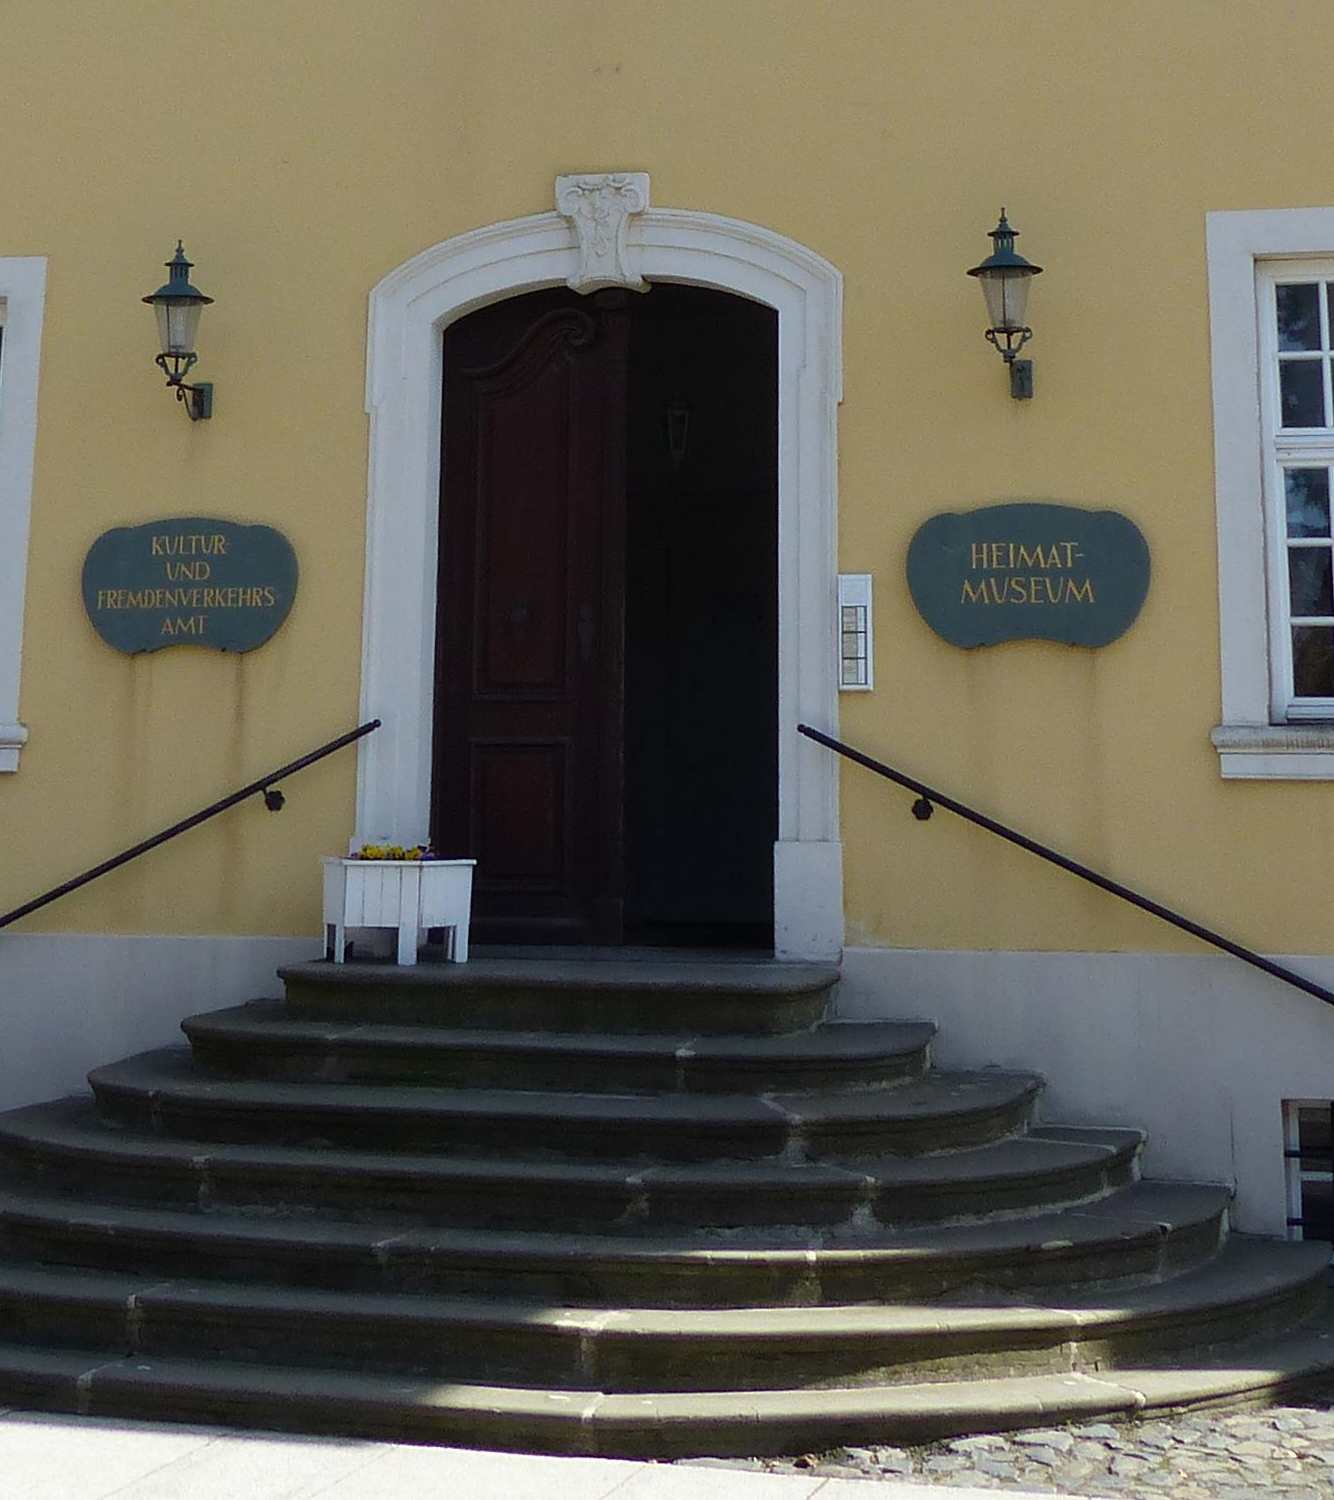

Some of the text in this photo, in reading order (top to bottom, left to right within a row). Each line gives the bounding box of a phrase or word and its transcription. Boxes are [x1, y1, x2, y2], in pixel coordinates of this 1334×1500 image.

[151, 535, 229, 555] KULTUR-
[971, 542, 1085, 569] HEIMAT-
[166, 561, 211, 581] UND
[98, 587, 275, 610] FREMDENVERKEHRS
[961, 577, 1095, 604] MUSEUM
[161, 615, 208, 635] AMT
